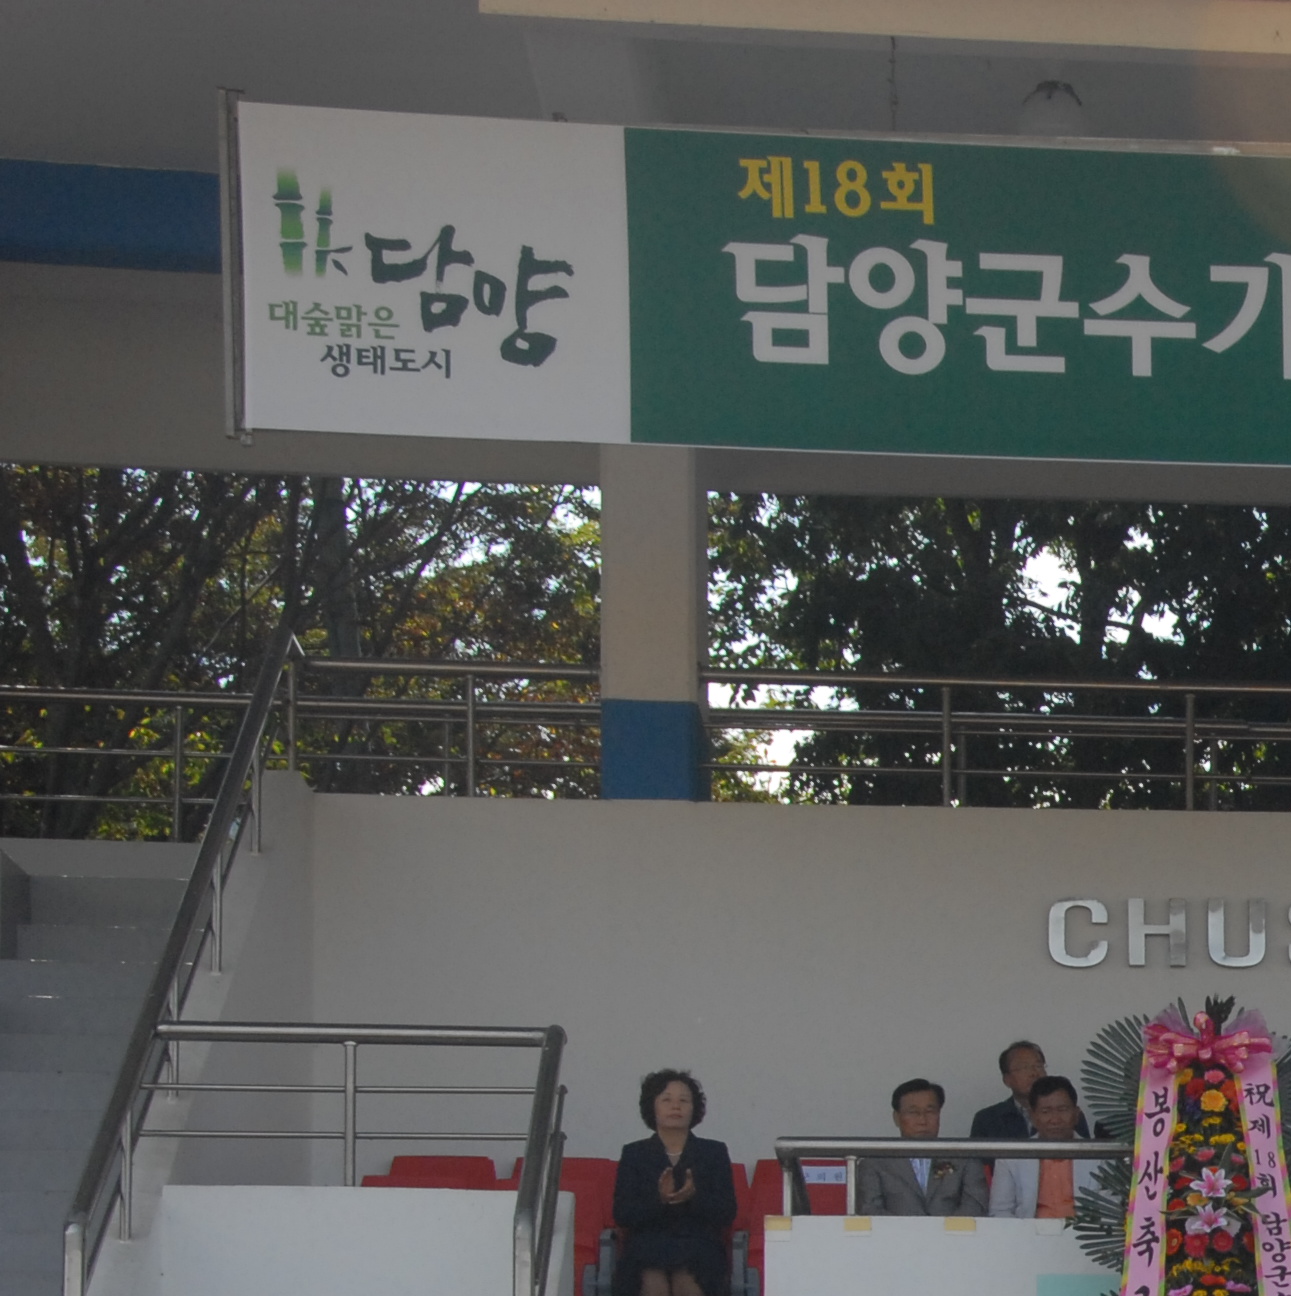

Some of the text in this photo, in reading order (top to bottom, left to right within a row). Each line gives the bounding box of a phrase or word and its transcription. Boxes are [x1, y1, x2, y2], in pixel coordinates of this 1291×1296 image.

[738, 155, 936, 226] 제18회
[267, 299, 401, 341] 대숲맑은
[365, 224, 574, 368] 담양
[319, 342, 453, 380] 생태도시
